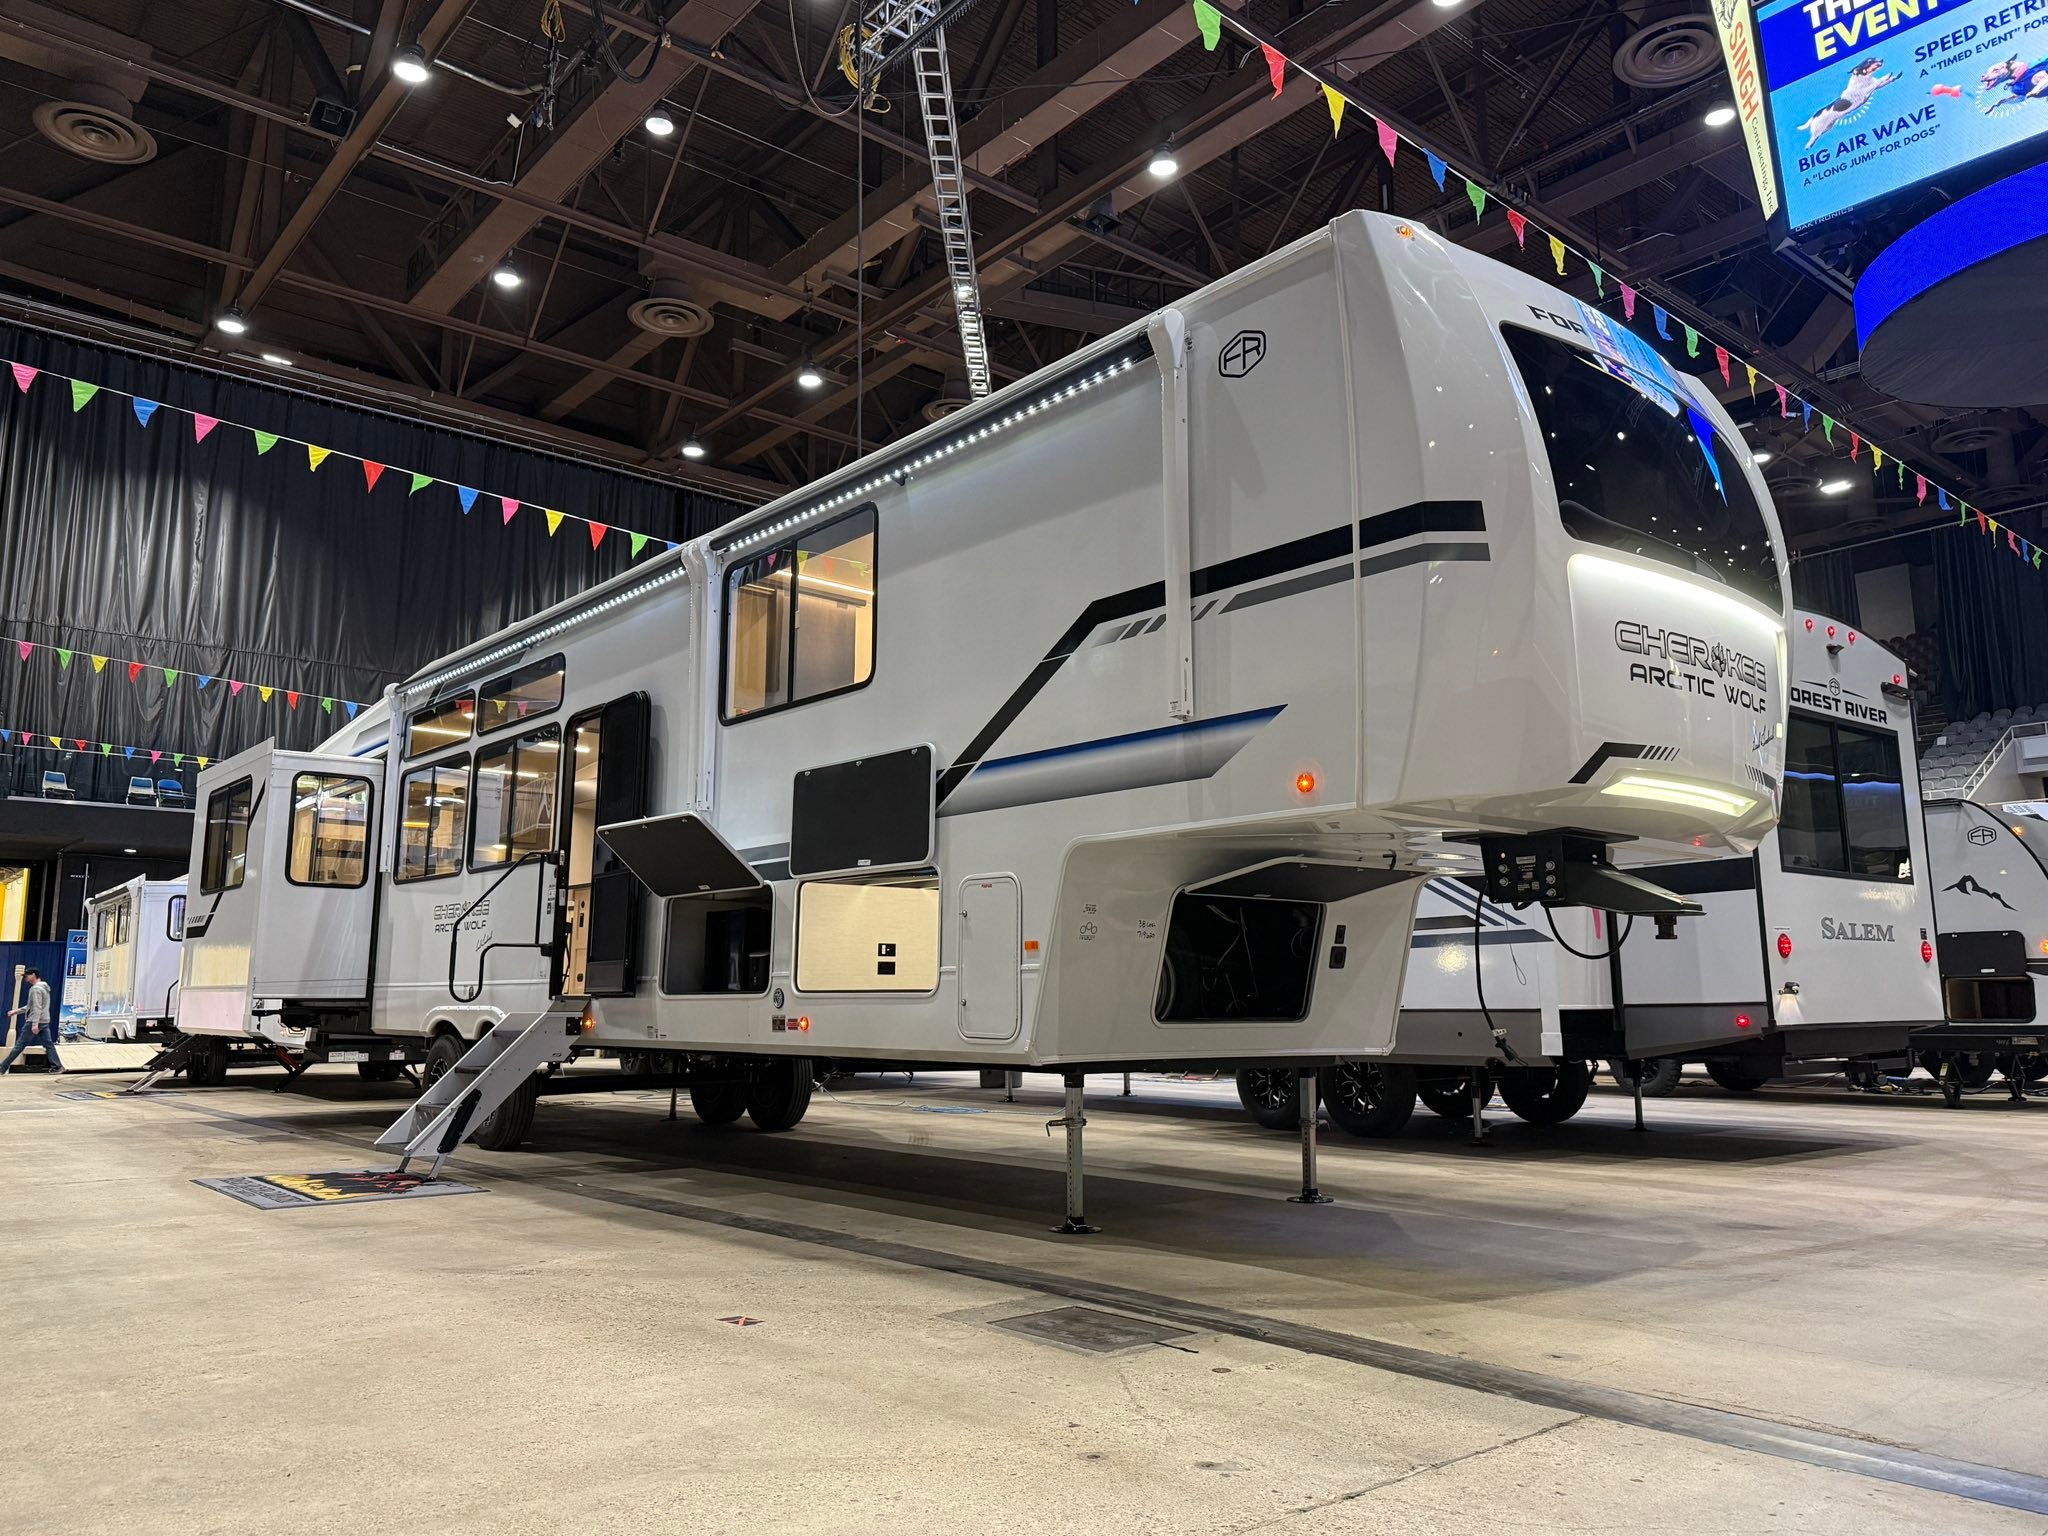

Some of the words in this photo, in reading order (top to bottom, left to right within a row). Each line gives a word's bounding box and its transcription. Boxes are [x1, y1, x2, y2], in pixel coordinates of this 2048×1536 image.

[1914, 25, 1978, 63] SPEED
[1920, 68, 1929, 78] A
[2024, 15, 2048, 33] FOR
[1729, 21, 1759, 122] SINGH
[1798, 148, 1831, 173] BIG
[1835, 133, 1869, 158] AIR
[1872, 104, 1937, 141] WAVE
[1803, 177, 1812, 188] A
[1849, 150, 1877, 168] JUMP
[1879, 140, 1902, 156] FOR
[1629, 663, 1716, 698] ARCTIC
[1723, 683, 1767, 714] WOLF
[1790, 686, 1842, 713] OREST
[1844, 700, 1888, 725] RIVER
[434, 922, 461, 933] ARCTC
[463, 920, 487, 931] WOLF
[1820, 916, 1896, 942] SALEM
